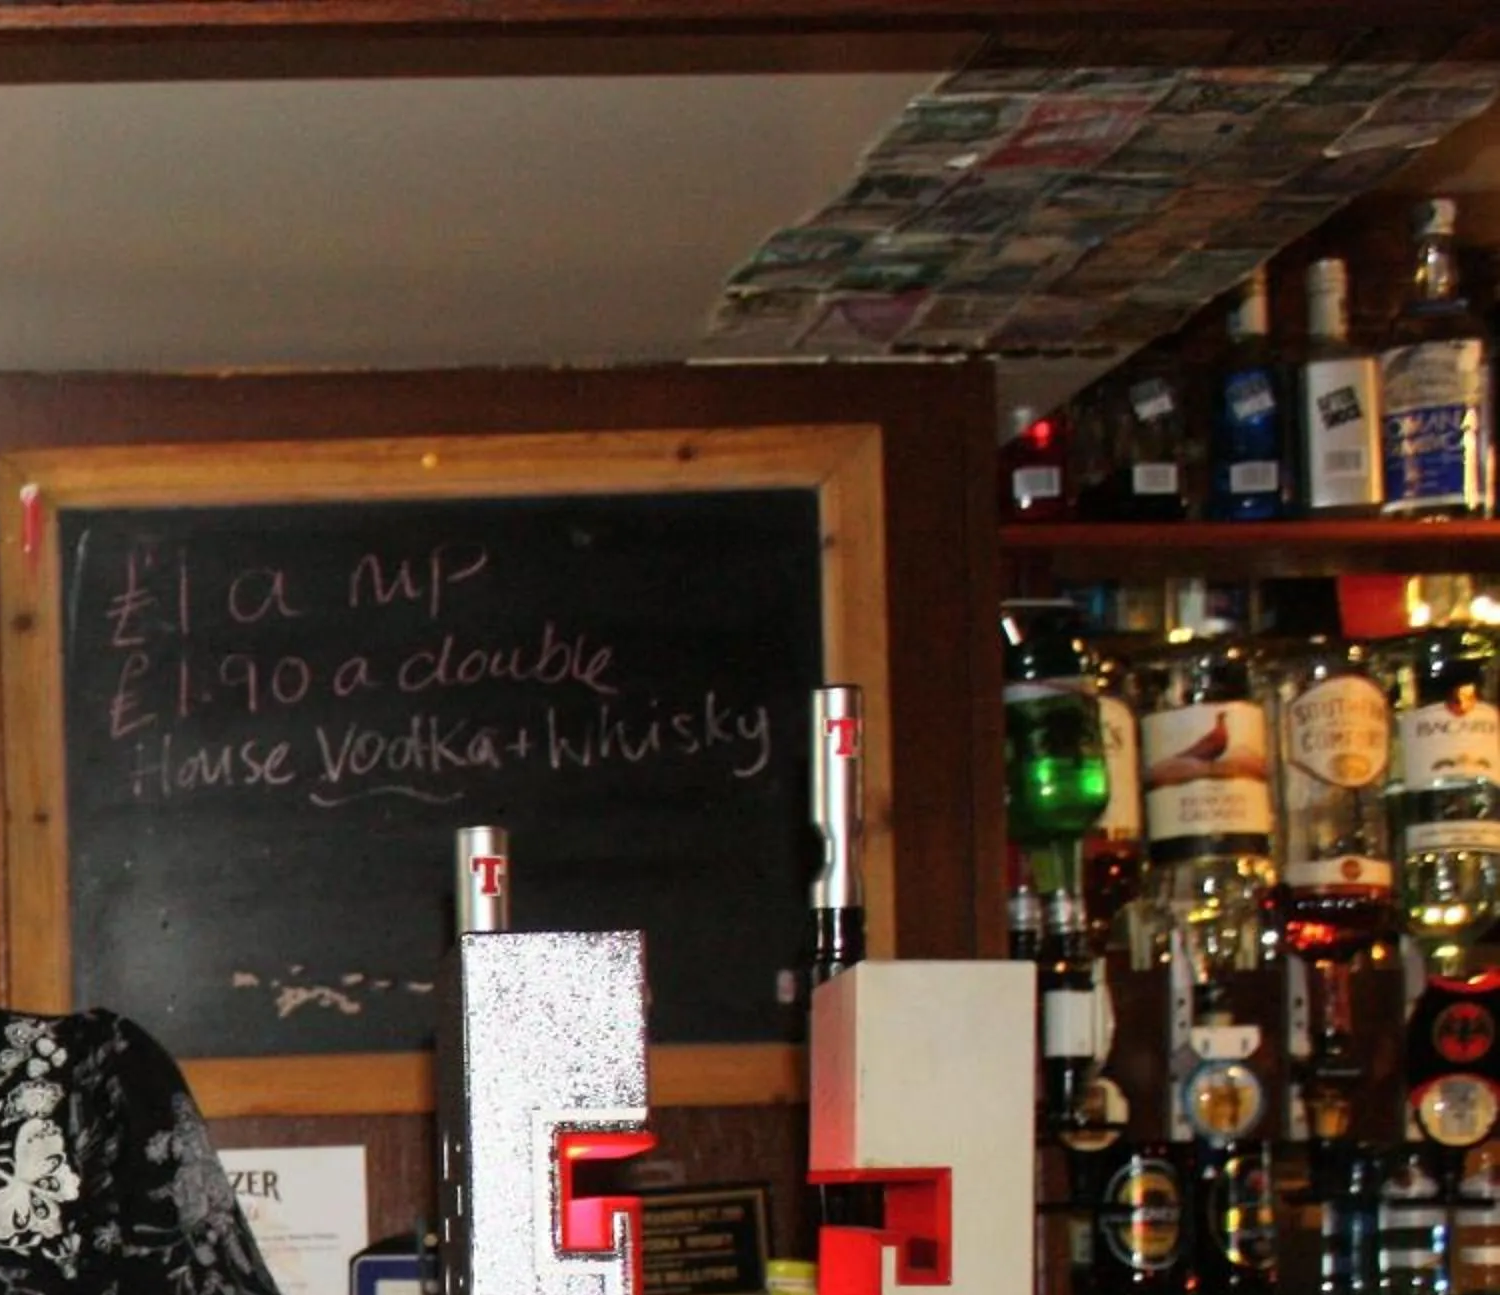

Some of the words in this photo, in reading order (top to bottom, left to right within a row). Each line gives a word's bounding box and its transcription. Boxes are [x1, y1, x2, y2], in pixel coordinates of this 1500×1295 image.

[227, 566, 301, 623] a
[109, 650, 310, 739] £1.90
[333, 659, 385, 696] a
[399, 621, 621, 695] double
[133, 733, 297, 796] House
[824, 718, 861, 757] T
[470, 856, 505, 897] T
